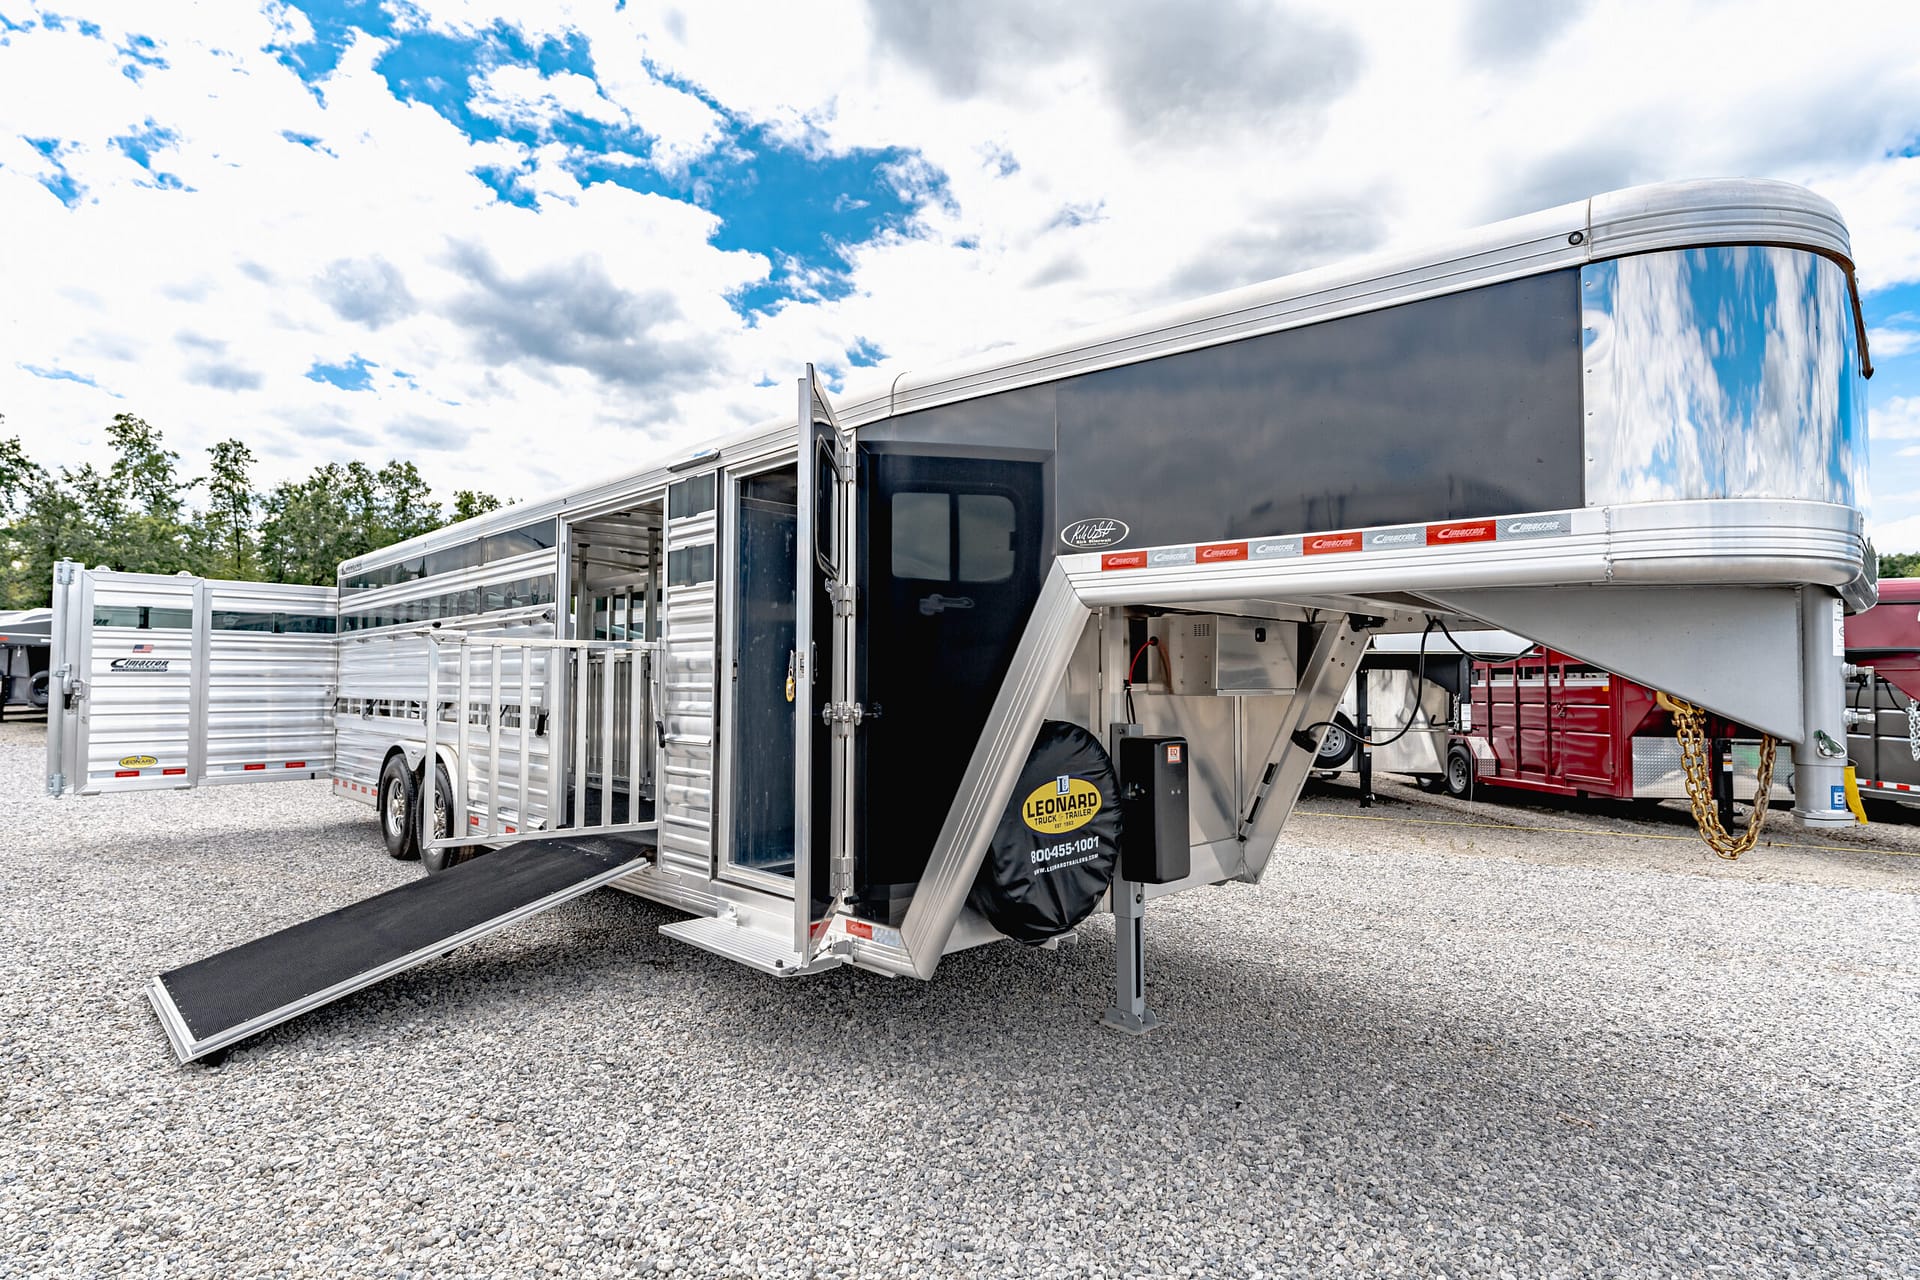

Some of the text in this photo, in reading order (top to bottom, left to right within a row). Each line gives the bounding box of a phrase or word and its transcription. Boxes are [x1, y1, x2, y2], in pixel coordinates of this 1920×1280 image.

[1026, 792, 1098, 818] LEONARD
[1034, 814, 1057, 826] TRUCK
[1065, 808, 1092, 819] TRAILER
